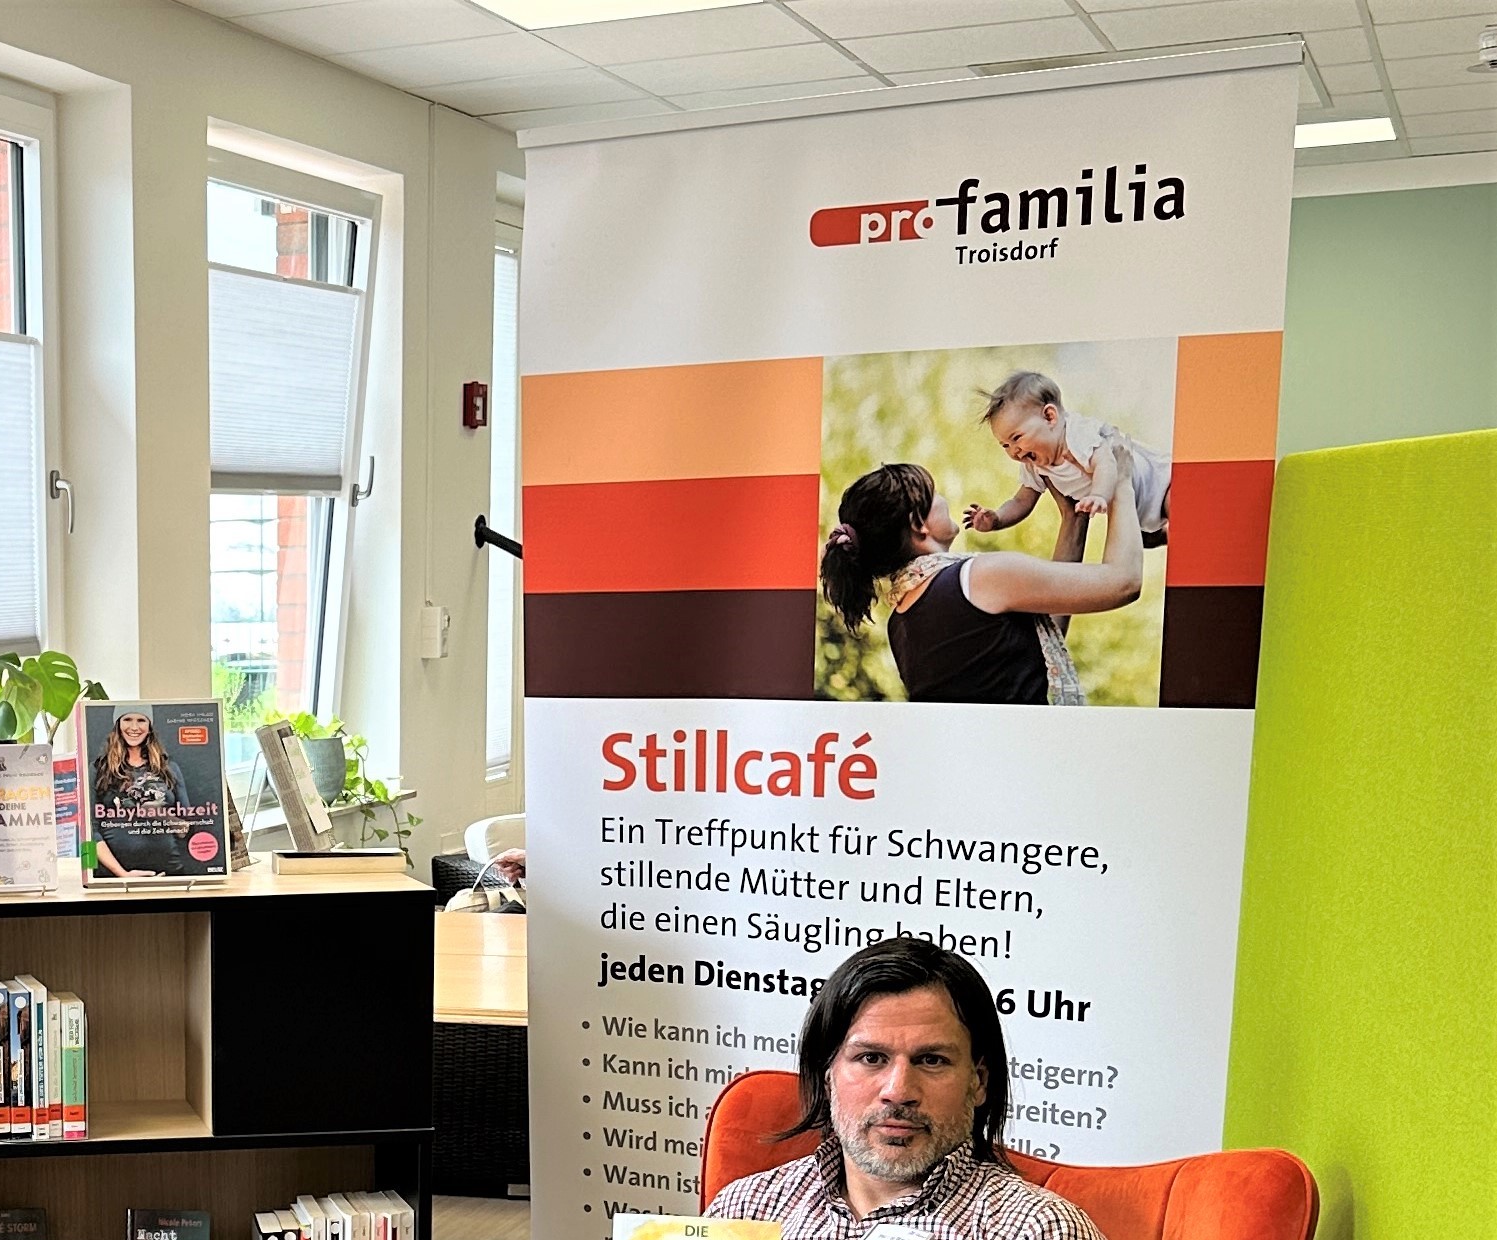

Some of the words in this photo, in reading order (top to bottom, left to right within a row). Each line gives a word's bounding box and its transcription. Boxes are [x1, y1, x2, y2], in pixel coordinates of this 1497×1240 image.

[860, 206, 936, 243] pro
[935, 164, 1186, 235] familia
[956, 238, 1060, 265] Troisdorf
[602, 730, 878, 800] Stillcafé
[94, 801, 219, 821] Babybauchzeit
[601, 817, 645, 845] Ein
[654, 818, 820, 857] Treffpunkt
[828, 826, 878, 858] für
[886, 829, 1109, 876] Schwangere,
[601, 863, 731, 893] stillende
[740, 867, 851, 902] Mütter
[860, 875, 923, 905] und
[934, 879, 1045, 919] Eltern,
[600, 904, 645, 931] die
[654, 908, 737, 938] einen
[747, 911, 884, 955] Säugling
[598, 952, 684, 988] jeden
[1027, 989, 1091, 1022] Uhr
[602, 1015, 646, 1038] Wie
[654, 1018, 709, 1045] kann
[716, 1025, 746, 1049] ich
[753, 1033, 796, 1055] mei
[603, 1053, 661, 1078] Kann
[668, 1058, 698, 1082] ich
[1009, 1057, 1119, 1090] teigern?
[603, 1090, 662, 1115] Muss
[668, 1096, 698, 1119] ich
[1006, 1100, 1107, 1130] ereiten?
[603, 1127, 657, 1151] Wird
[664, 1138, 704, 1158] mei
[603, 1163, 670, 1190] Wann
[676, 1171, 700, 1195] ist
[7, 1222, 37, 1233] STORM
[137, 1229, 178, 1240] Nacht
[685, 1224, 709, 1238] DIE
